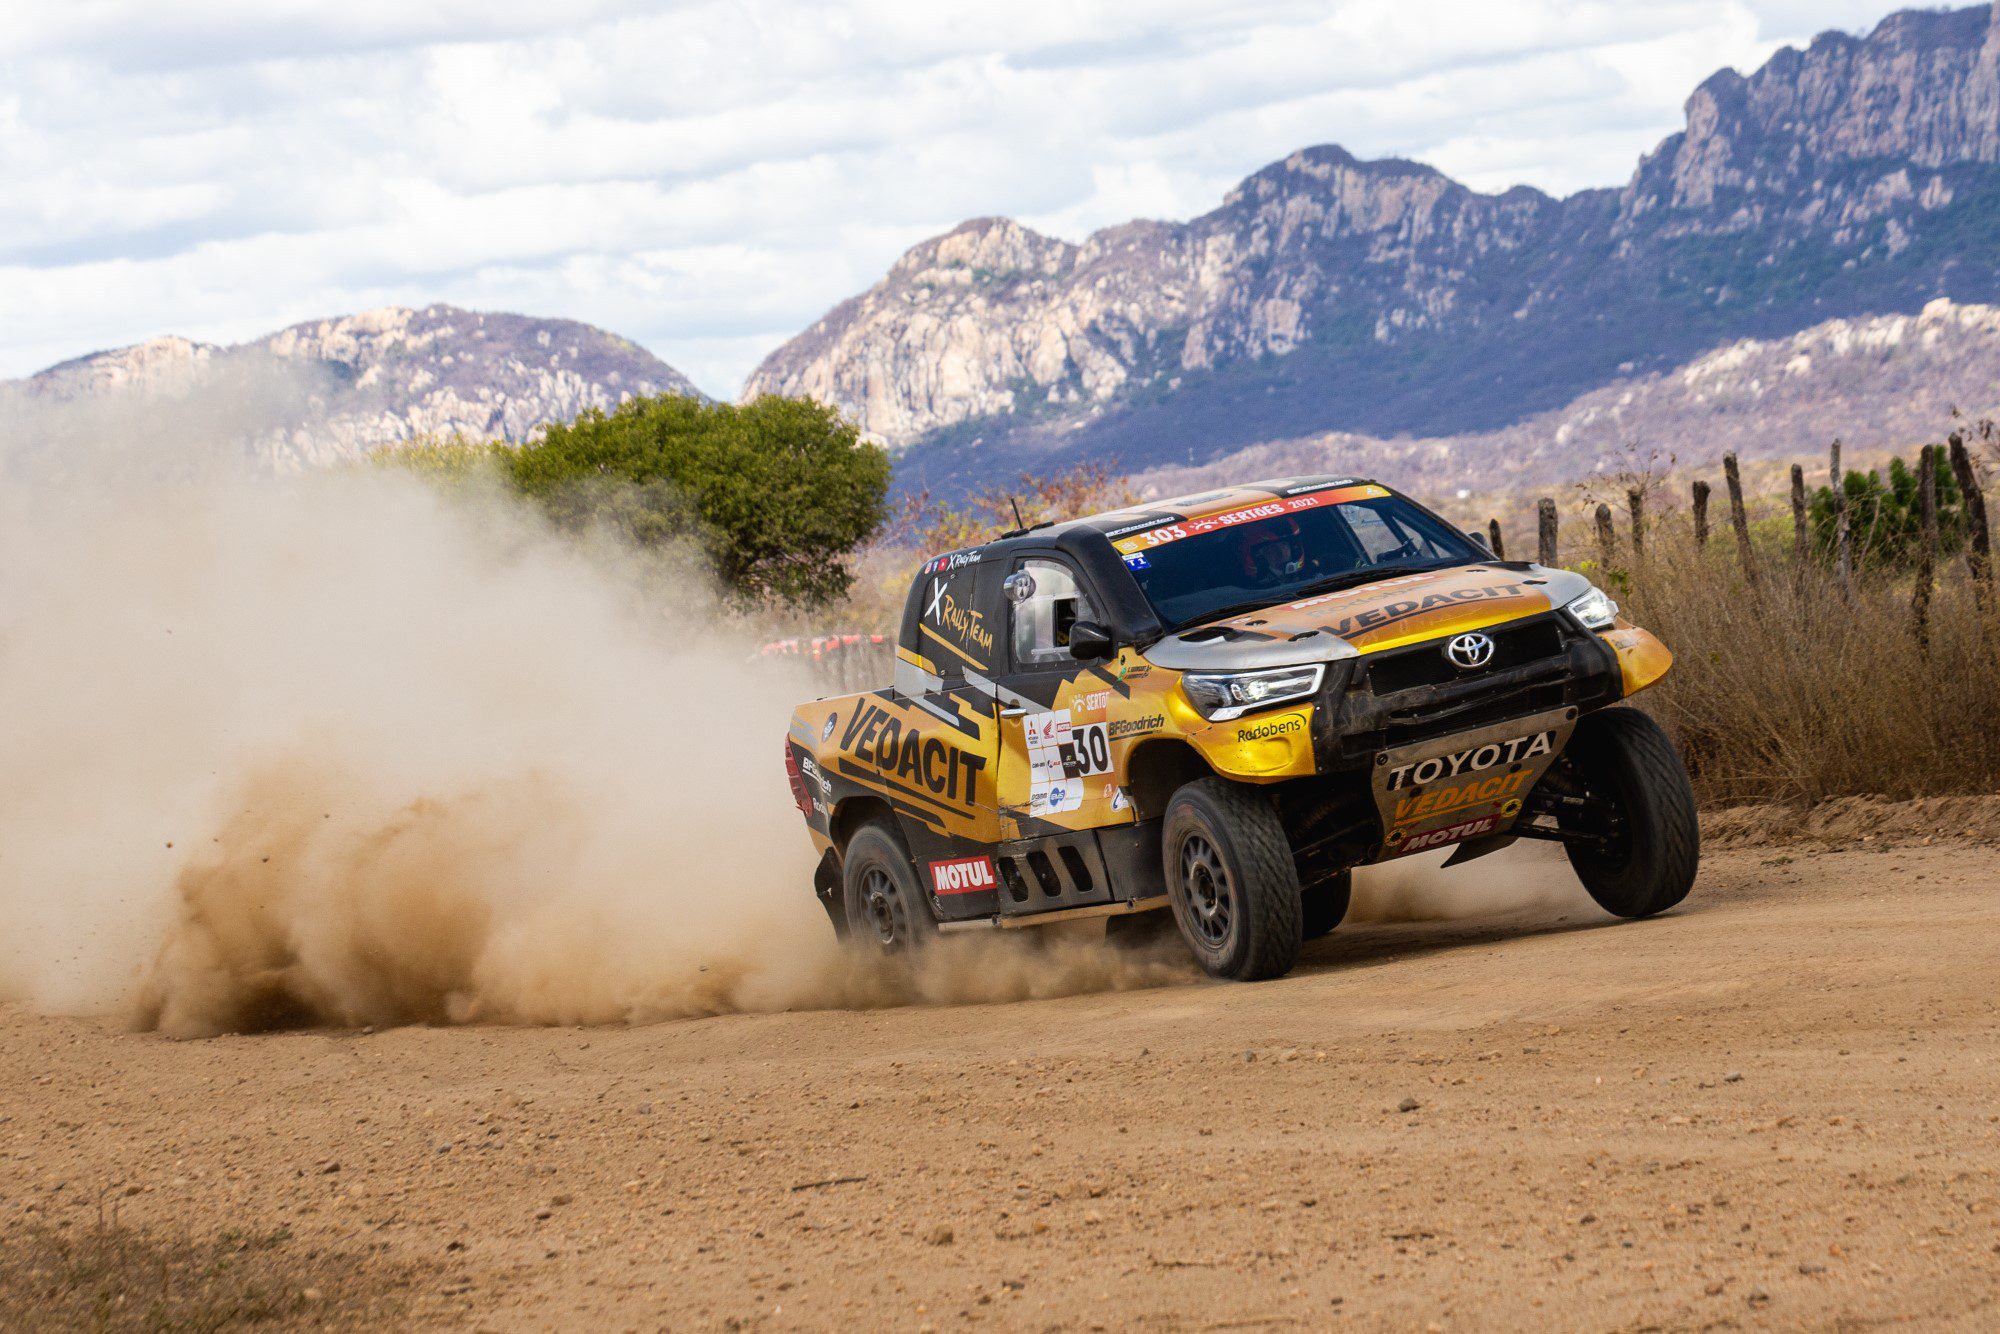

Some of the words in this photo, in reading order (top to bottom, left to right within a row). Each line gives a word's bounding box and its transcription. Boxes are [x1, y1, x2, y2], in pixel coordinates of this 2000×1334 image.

[1140, 525, 1187, 545] 303
[1288, 497, 1319, 509] 2021
[946, 553, 957, 571] X
[924, 577, 948, 626] X
[1317, 584, 1522, 635] VEDACIT
[1108, 714, 1165, 736] BFGoodrich
[1237, 719, 1301, 743] Rodobens
[839, 697, 987, 807] VEDACIT
[1072, 725, 1108, 775] 30
[1390, 731, 1551, 791] TOYOTA
[1395, 770, 1533, 819] VEDACIT
[1401, 818, 1493, 851] MOTUL
[934, 860, 994, 891] MOTUL
